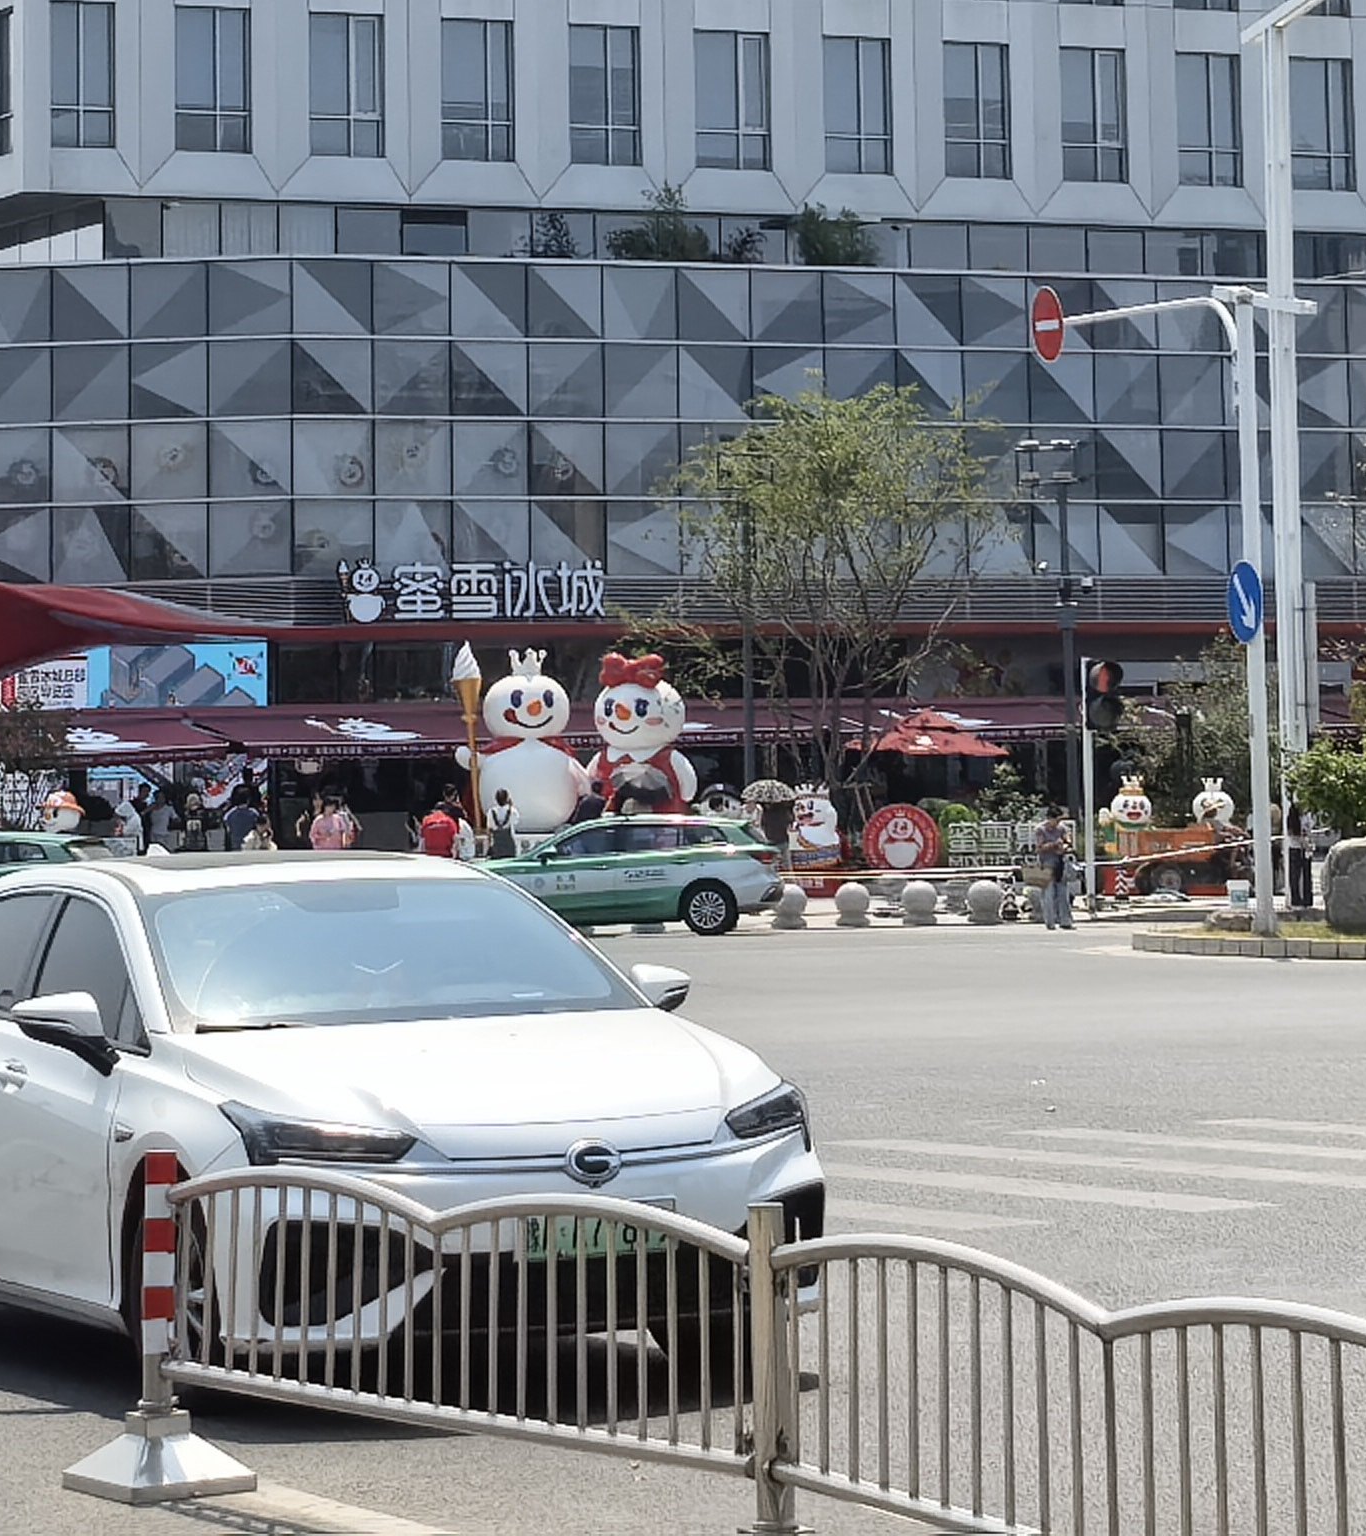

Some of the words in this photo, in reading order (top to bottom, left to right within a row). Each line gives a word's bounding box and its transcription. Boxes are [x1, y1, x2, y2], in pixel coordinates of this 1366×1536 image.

[392, 559, 607, 620] 蜜雪冰城
[947, 819, 1077, 855] 蜜雪集
